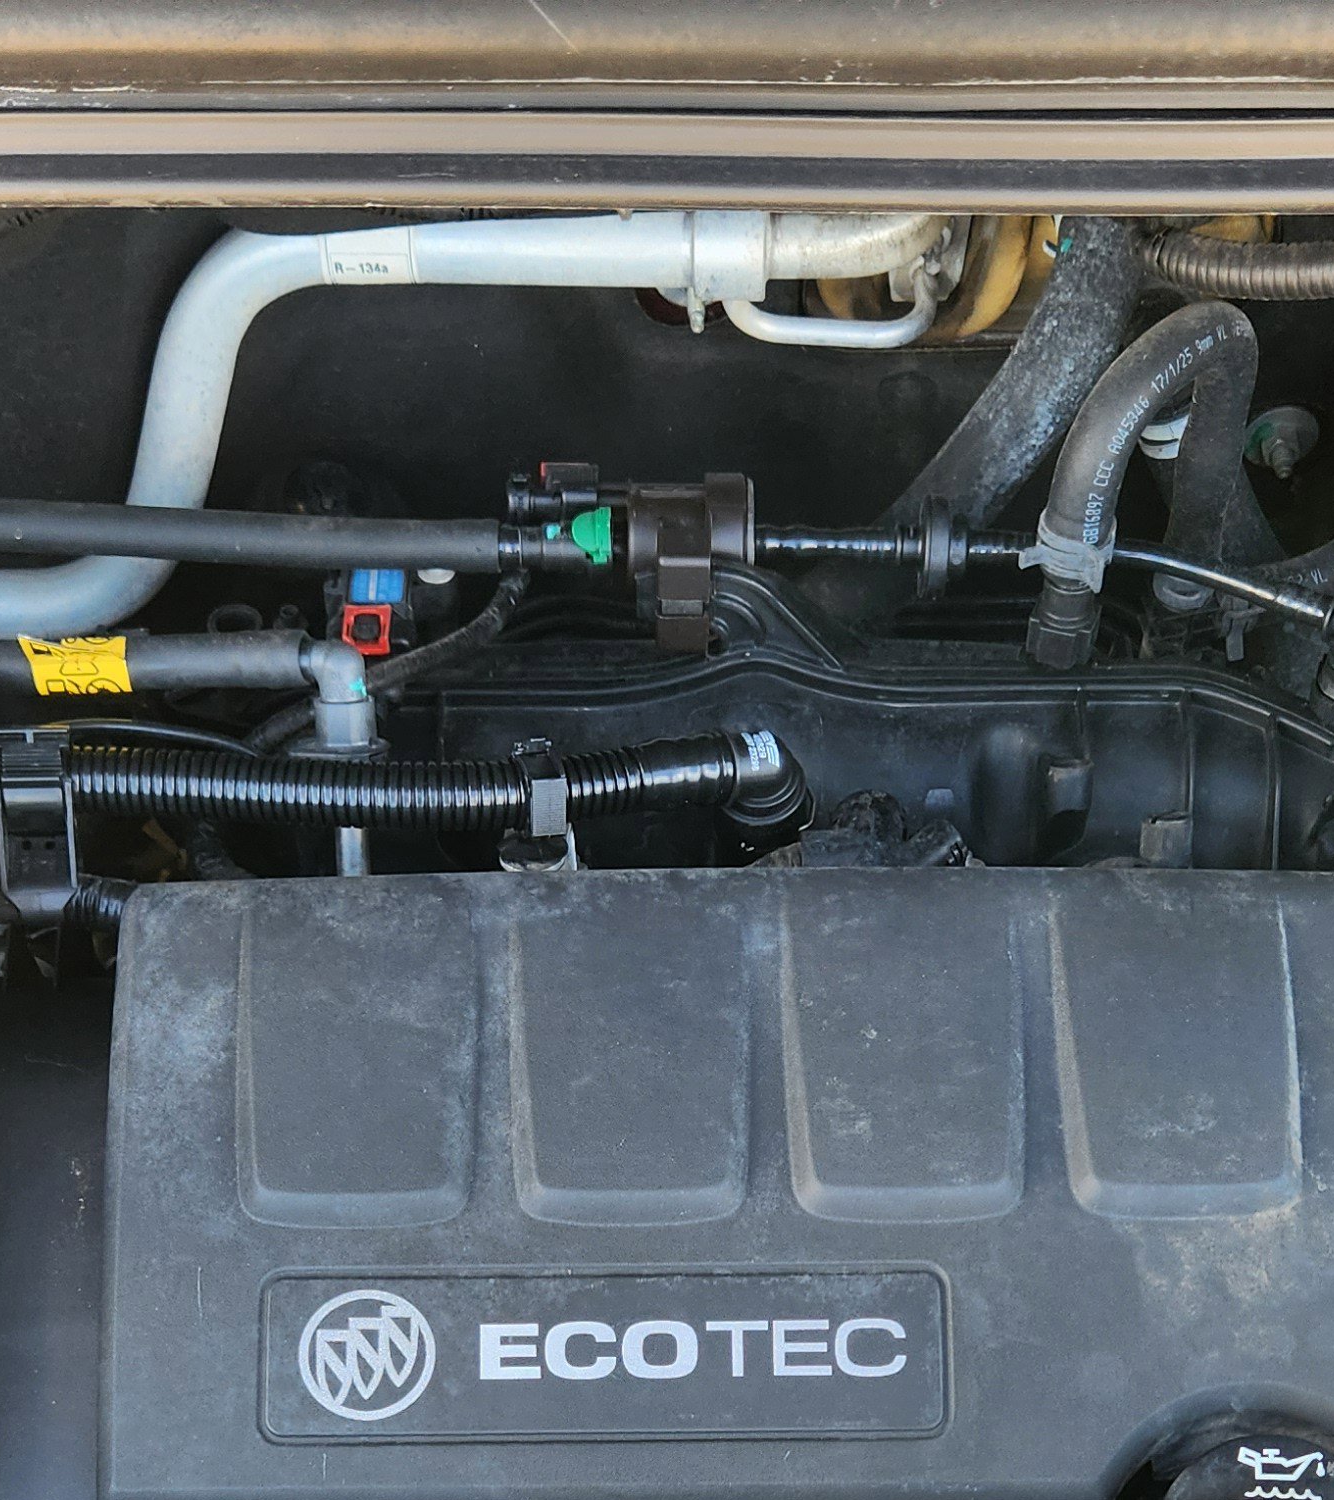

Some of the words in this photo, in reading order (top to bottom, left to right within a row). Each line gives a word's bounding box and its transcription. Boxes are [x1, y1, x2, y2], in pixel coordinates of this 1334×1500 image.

[1093, 460, 1115, 487] CCC
[1083, 493, 1105, 545] GB16897
[479, 1318, 908, 1380] ECOTEC
